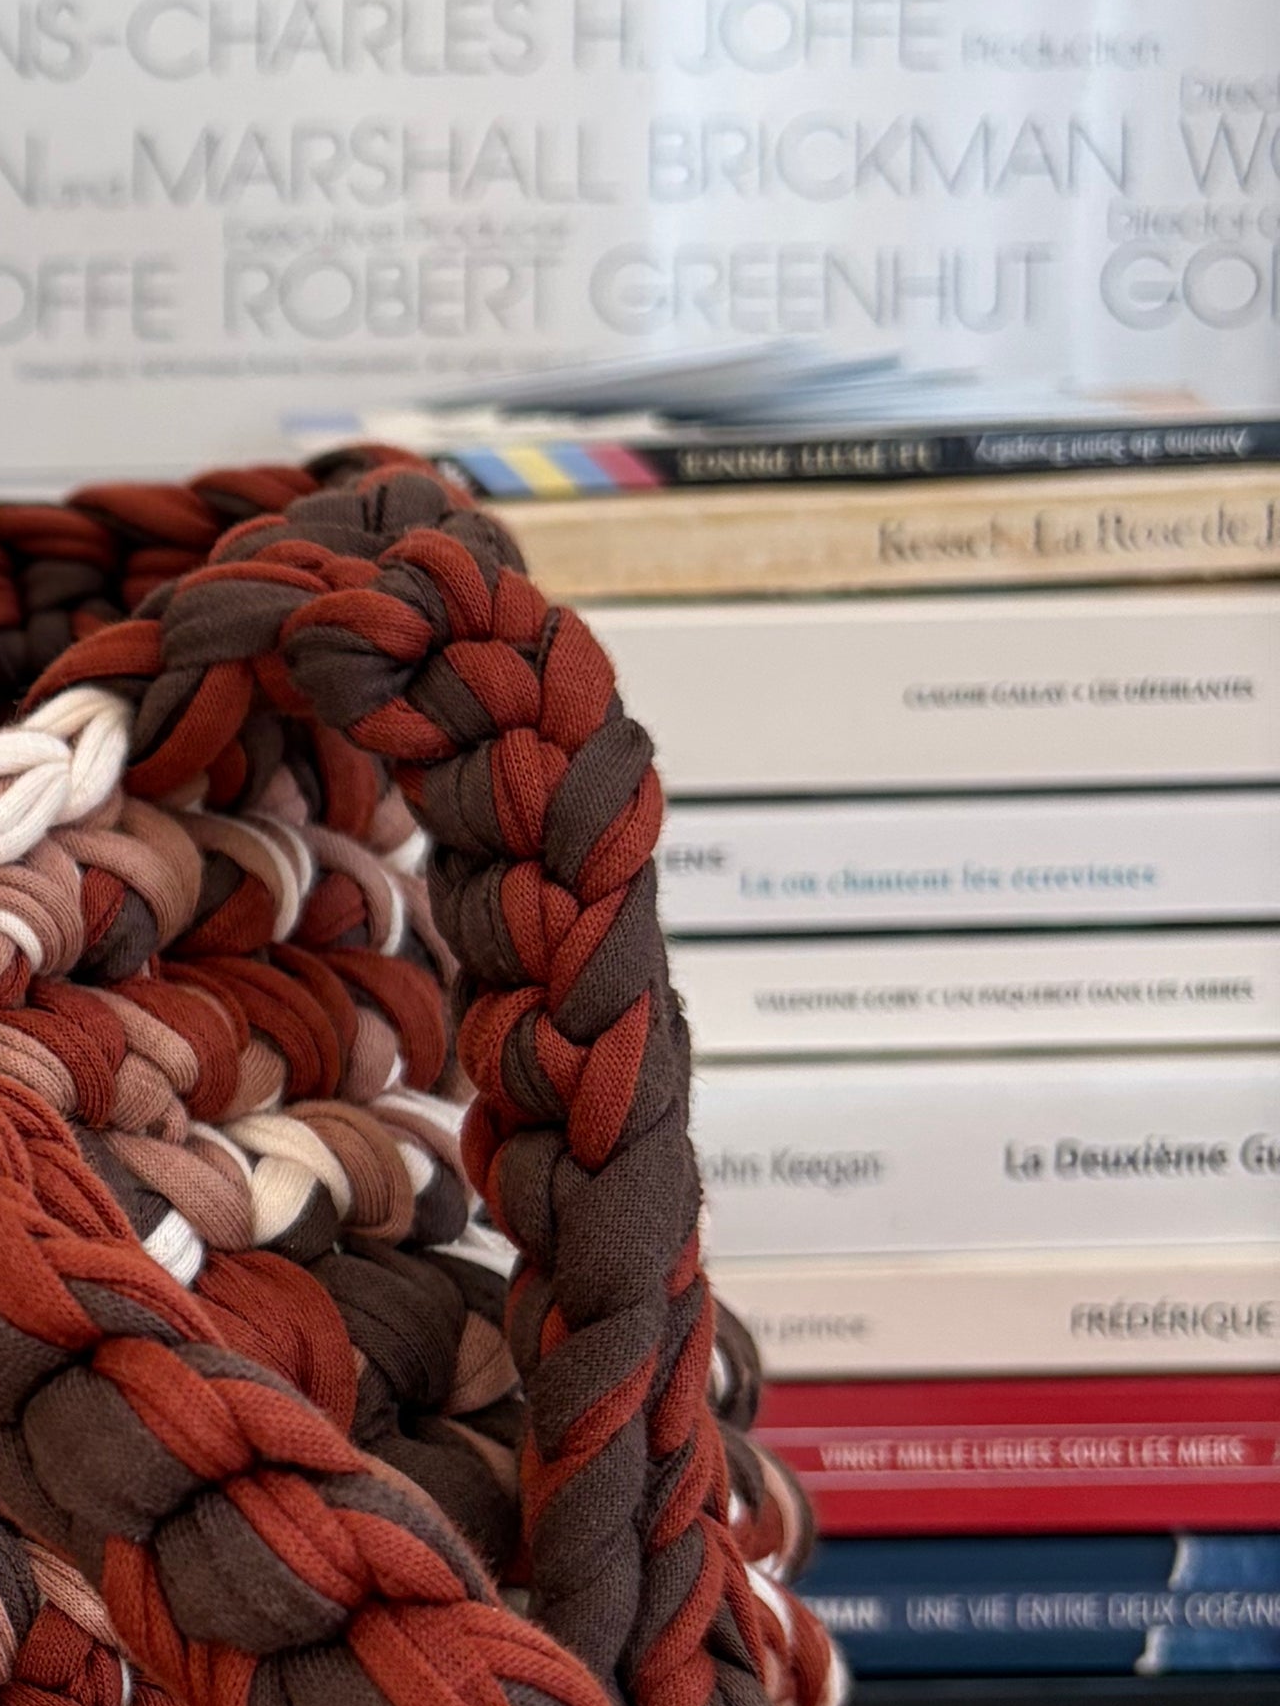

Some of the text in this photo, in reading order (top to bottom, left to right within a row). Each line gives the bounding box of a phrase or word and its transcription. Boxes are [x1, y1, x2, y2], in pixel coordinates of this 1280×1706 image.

[133, 113, 618, 211] MARSHALL
[648, 111, 1134, 203] BRICKMAN
[223, 249, 564, 341] ROBERT
[588, 241, 1054, 337] GREENHUT
[702, 1146, 764, 1186] ohn
[1002, 1139, 1044, 1181] La
[800, 1594, 886, 1632] MAN
[905, 1594, 962, 1634] UNE
[966, 1594, 1010, 1633] VIE
[1015, 1593, 1101, 1633] ENTRE
[1107, 1592, 1177, 1631] DEUX
